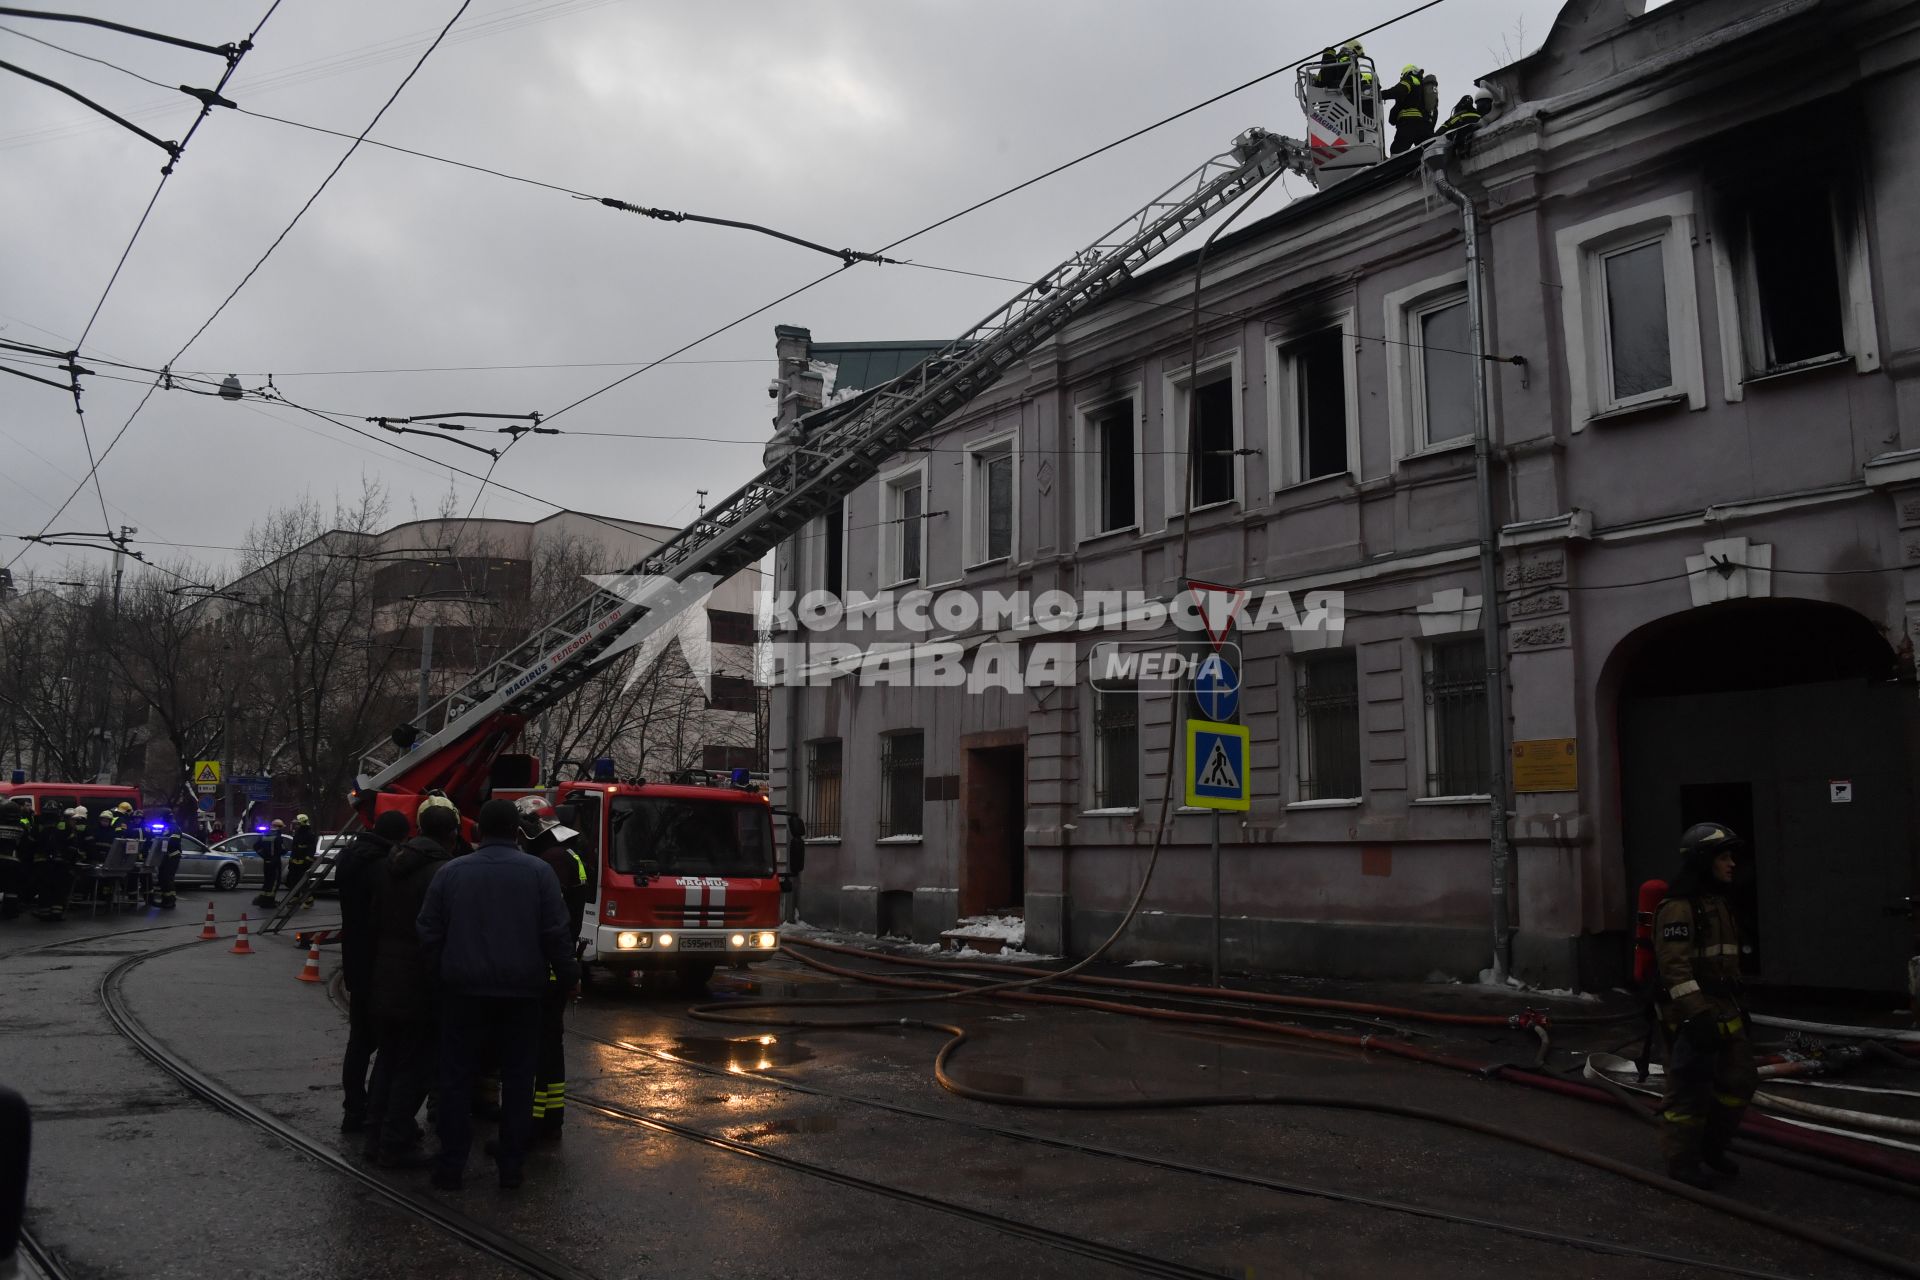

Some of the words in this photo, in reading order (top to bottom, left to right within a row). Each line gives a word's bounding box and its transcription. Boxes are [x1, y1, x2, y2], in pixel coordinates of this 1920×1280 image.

[1309, 112, 1342, 137] MAGIRUS
[550, 632, 593, 665] ТЕЛЕФОН
[504, 663, 548, 698] MAGIRUS
[675, 878, 730, 887] MAGIRUS
[1664, 926, 1689, 937] 0143
